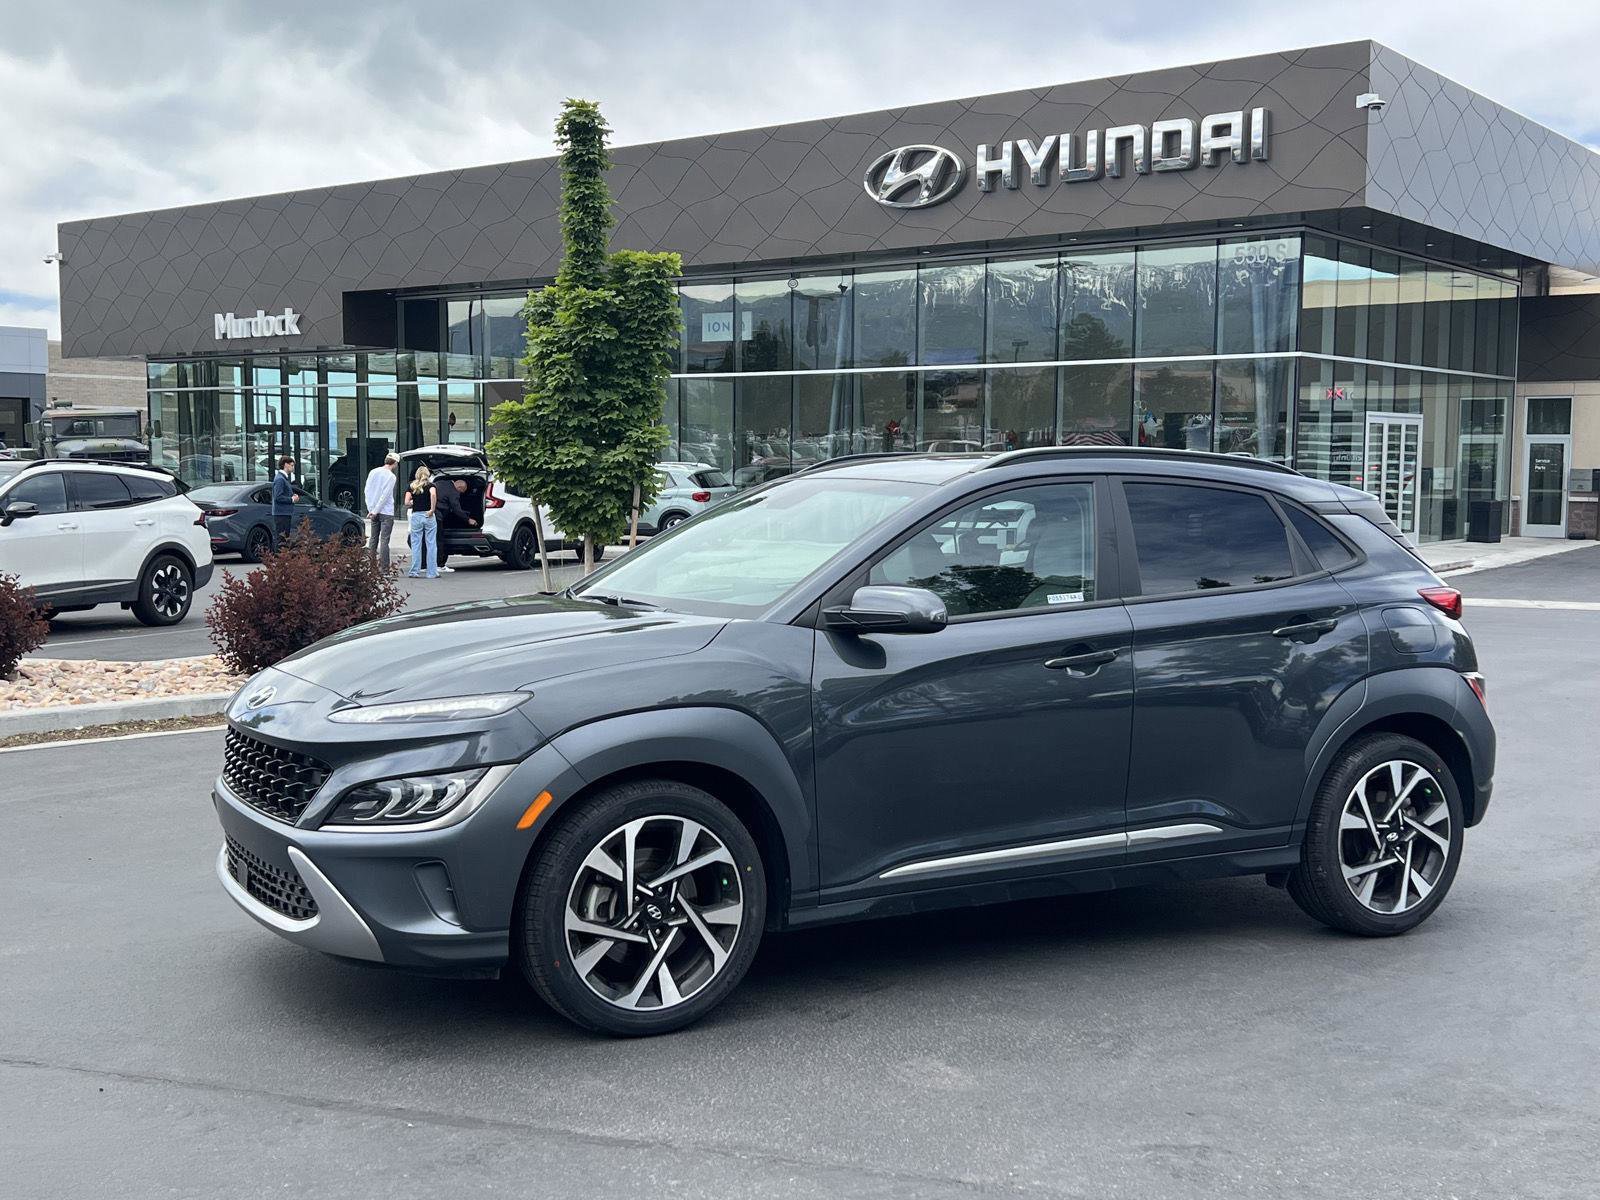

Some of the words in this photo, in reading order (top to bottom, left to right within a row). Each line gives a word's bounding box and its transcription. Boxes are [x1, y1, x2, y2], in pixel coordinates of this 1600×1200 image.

[976, 107, 1270, 193] HYUNDAI
[1234, 244, 1269, 264] 530
[214, 307, 301, 340] Murdock
